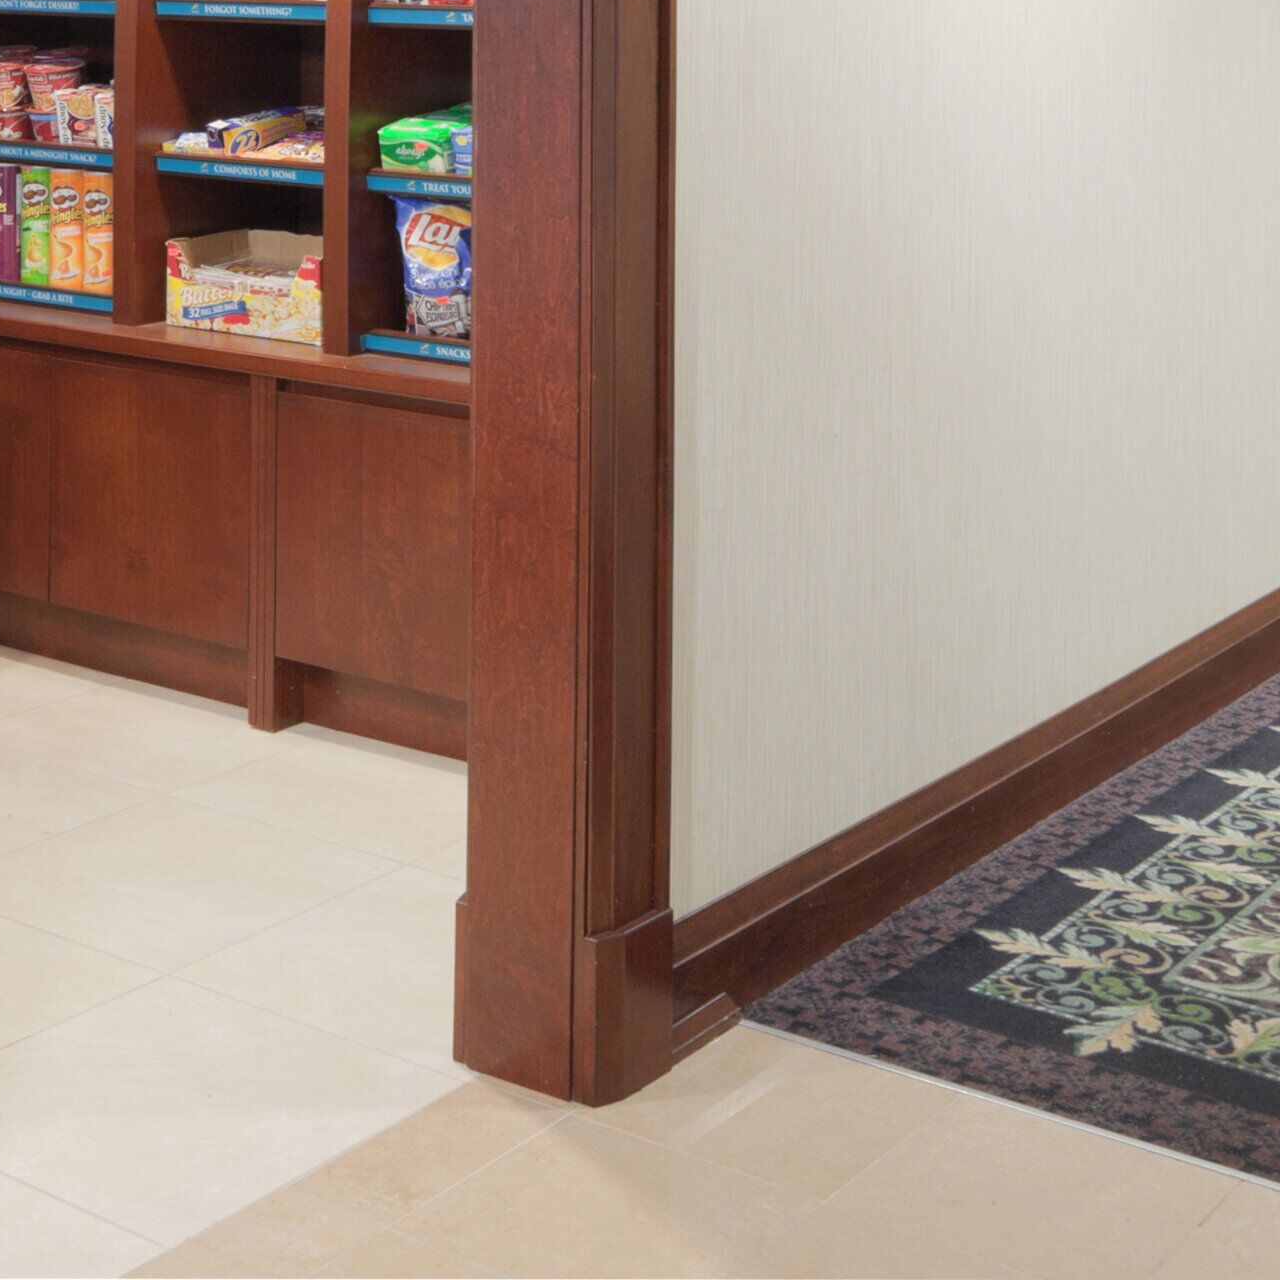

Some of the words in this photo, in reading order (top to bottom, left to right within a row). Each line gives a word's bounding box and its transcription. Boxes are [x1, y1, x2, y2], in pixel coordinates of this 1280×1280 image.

[20, 0, 47, 9] FORGET
[204, 5, 237, 14] FORGOT
[238, 6, 293, 16] SOMETHING?
[0, 146, 23, 156] ABOUT
[213, 164, 257, 177] COMFORTS
[258, 168, 269, 177] OF
[271, 170, 297, 180] HOME
[422, 182, 449, 193] TREAT
[3, 286, 26, 296] NIGHT
[188, 307, 200, 317] 32
[436, 346, 471, 359] SNACKS
